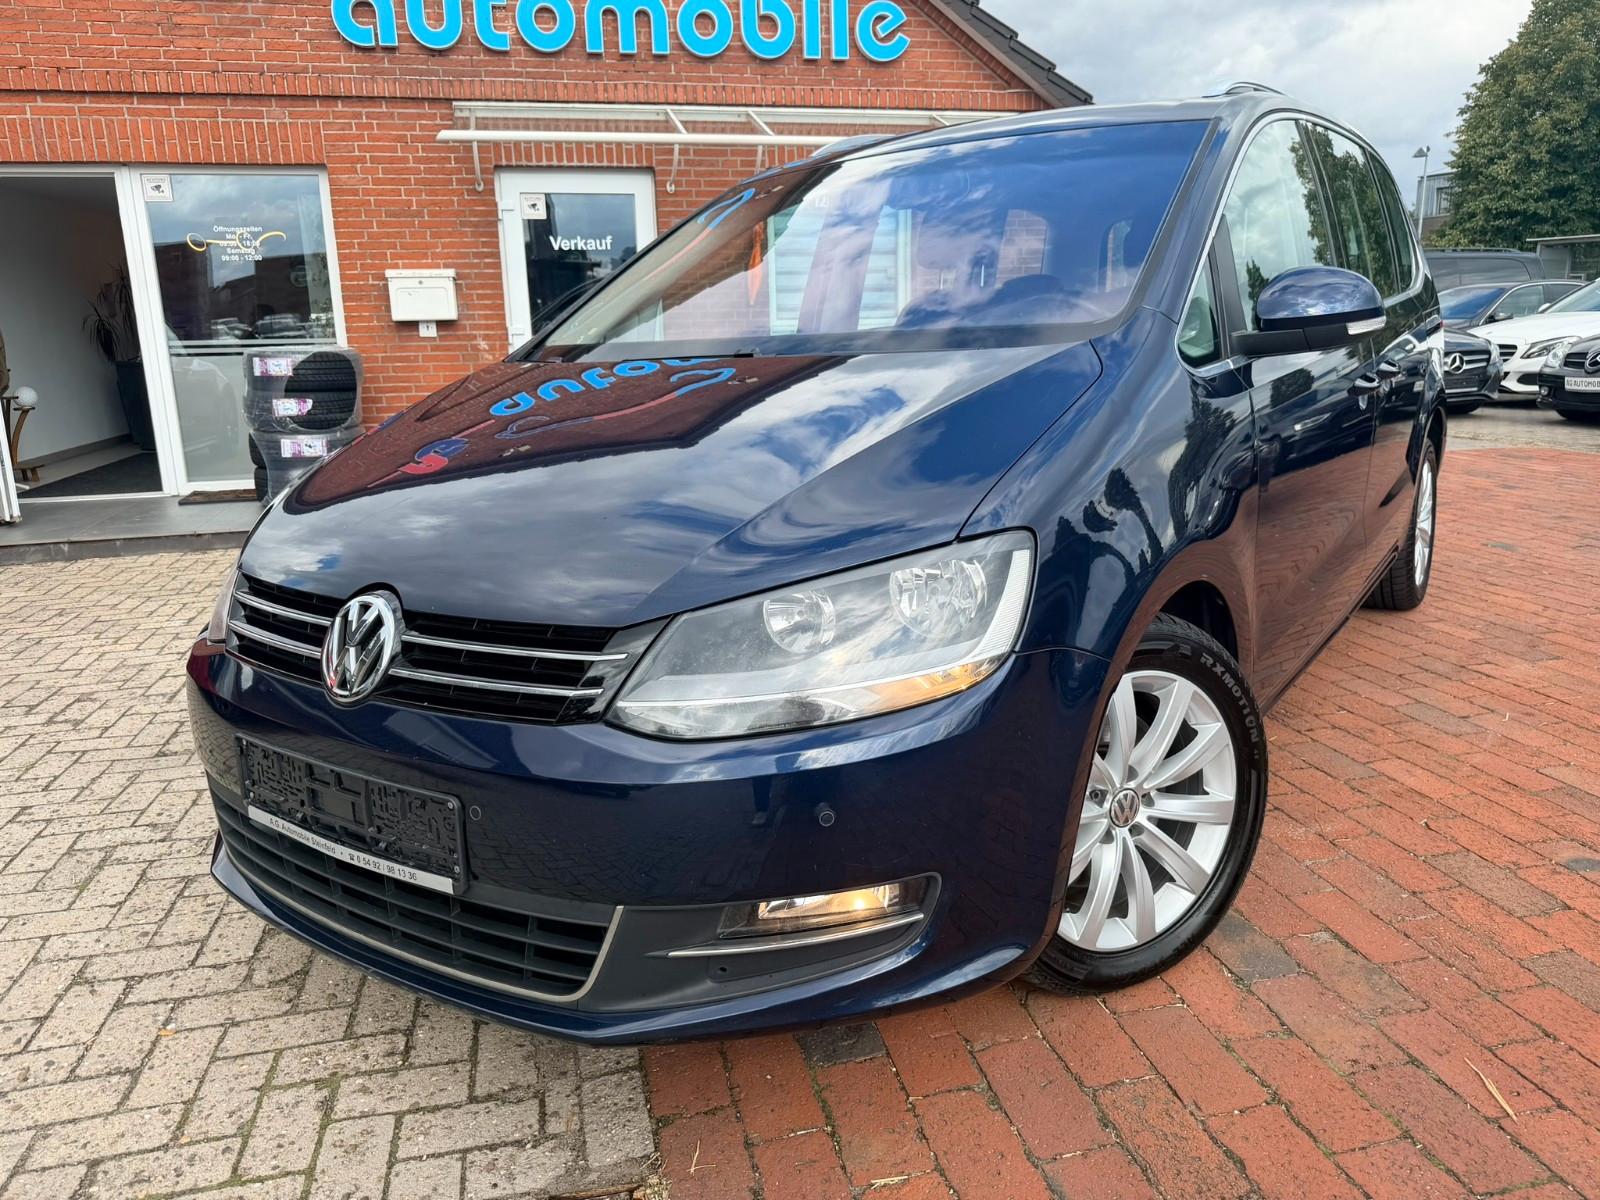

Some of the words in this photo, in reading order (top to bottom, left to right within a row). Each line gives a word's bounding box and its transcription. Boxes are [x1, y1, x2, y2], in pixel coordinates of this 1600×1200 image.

[331, 0, 911, 62] automobile
[549, 235, 613, 251] Verkauf
[362, 857, 371, 867] 54
[372, 860, 381, 870] 92
[397, 868, 406, 878] 13
[407, 871, 417, 881] 36
